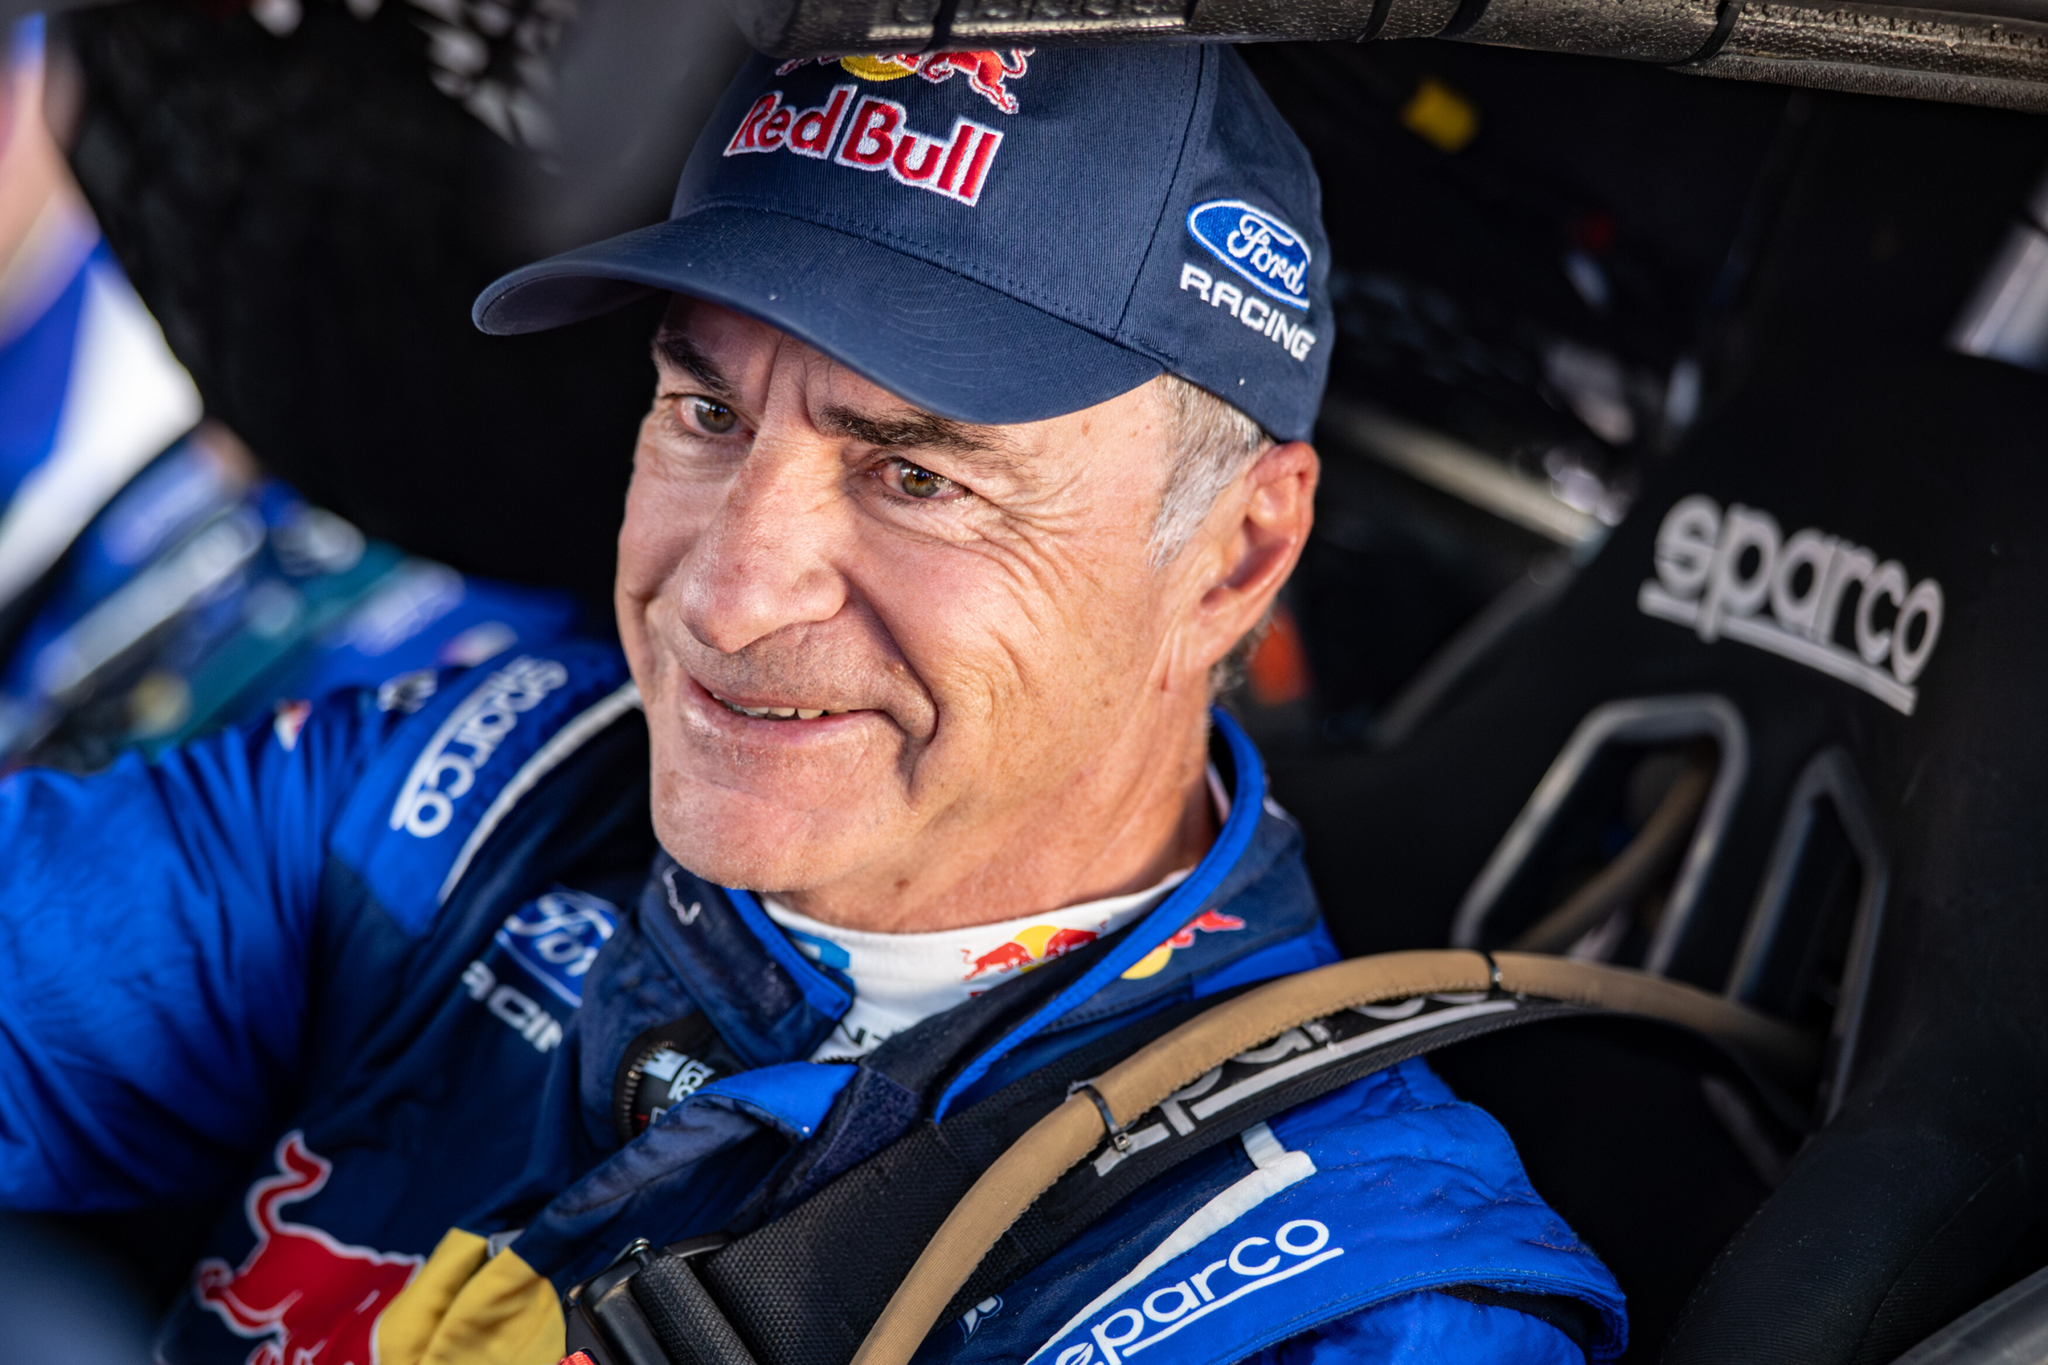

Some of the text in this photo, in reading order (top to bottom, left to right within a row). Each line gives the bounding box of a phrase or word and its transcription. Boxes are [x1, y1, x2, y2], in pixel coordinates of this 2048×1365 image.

[723, 85, 1005, 207] Red Bull
[1227, 214, 1307, 295] Ford
[1180, 262, 1316, 362] RACING
[1652, 492, 1944, 690] sparco
[403, 655, 569, 839] sparco
[503, 894, 615, 978] For
